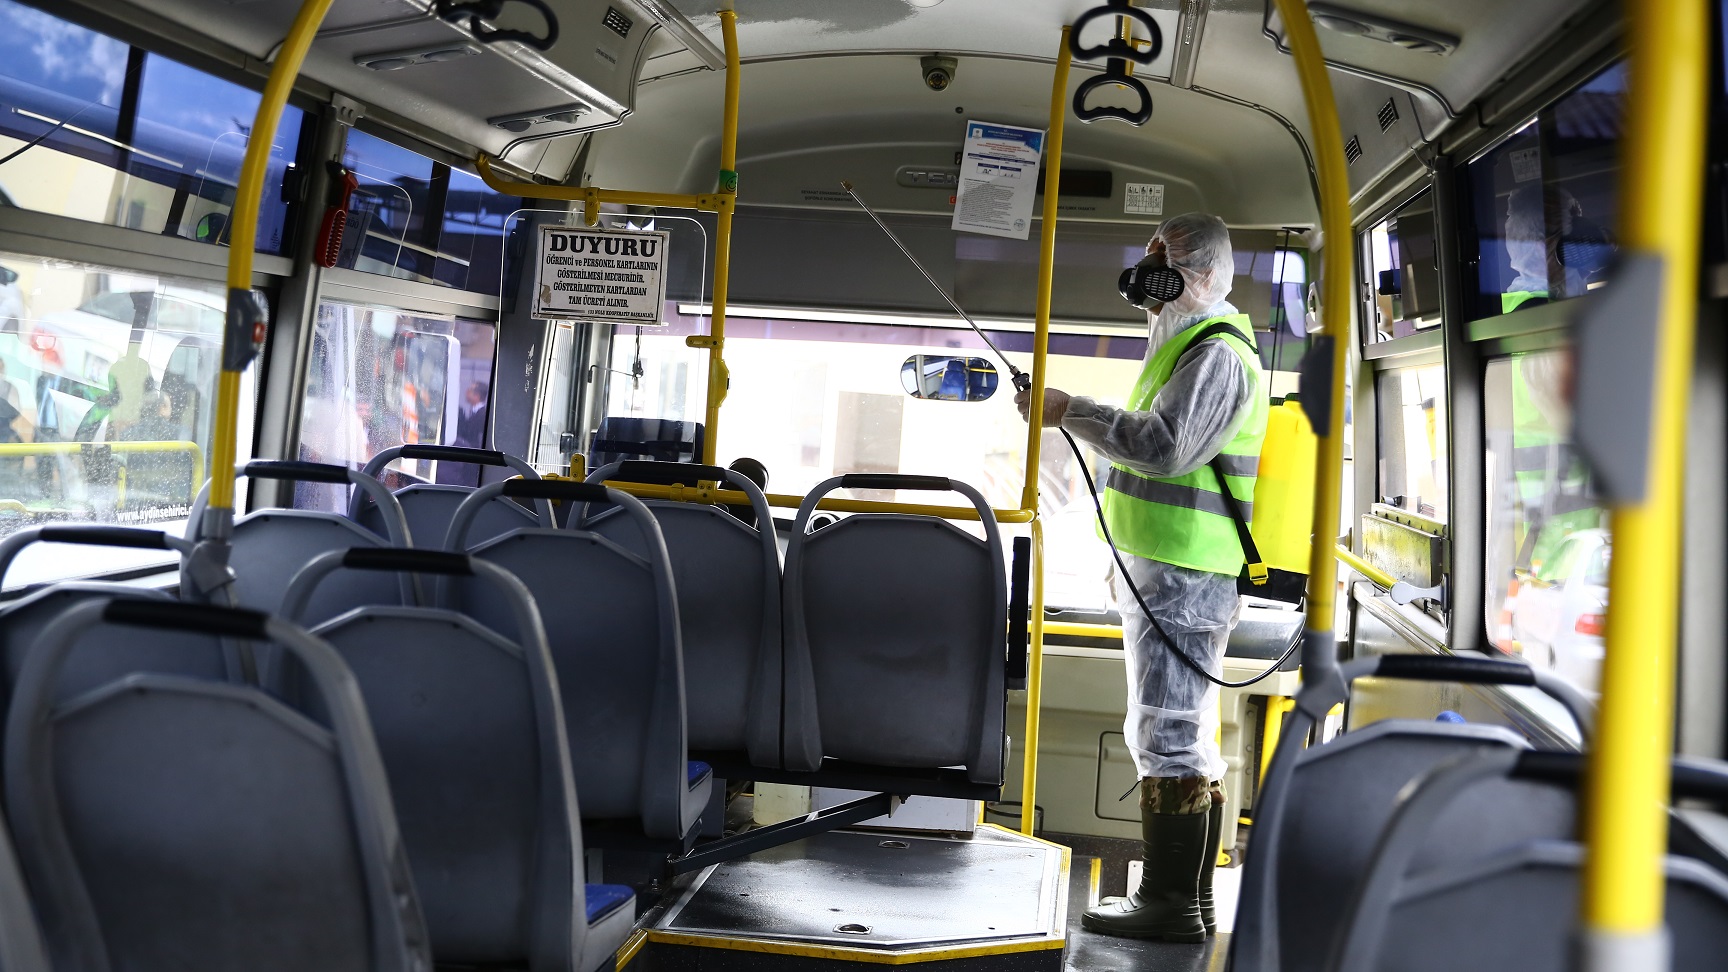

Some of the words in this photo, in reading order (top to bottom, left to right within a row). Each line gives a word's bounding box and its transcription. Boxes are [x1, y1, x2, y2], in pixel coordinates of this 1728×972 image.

[550, 234, 657, 257] DUYURU
[546, 254, 574, 266] ÖĞRENCİ
[583, 258, 616, 268] PERSONEL
[616, 260, 658, 271] KARTLARININ
[557, 268, 603, 280] GÖSTERİLMESİ
[553, 281, 606, 293] GÖSTERİLMEYEN
[606, 285, 647, 296] KARTLARDAN
[568, 296, 581, 304] TAM
[583, 295, 606, 306] ÜCRETİ
[606, 298, 629, 307] ALINIR.
